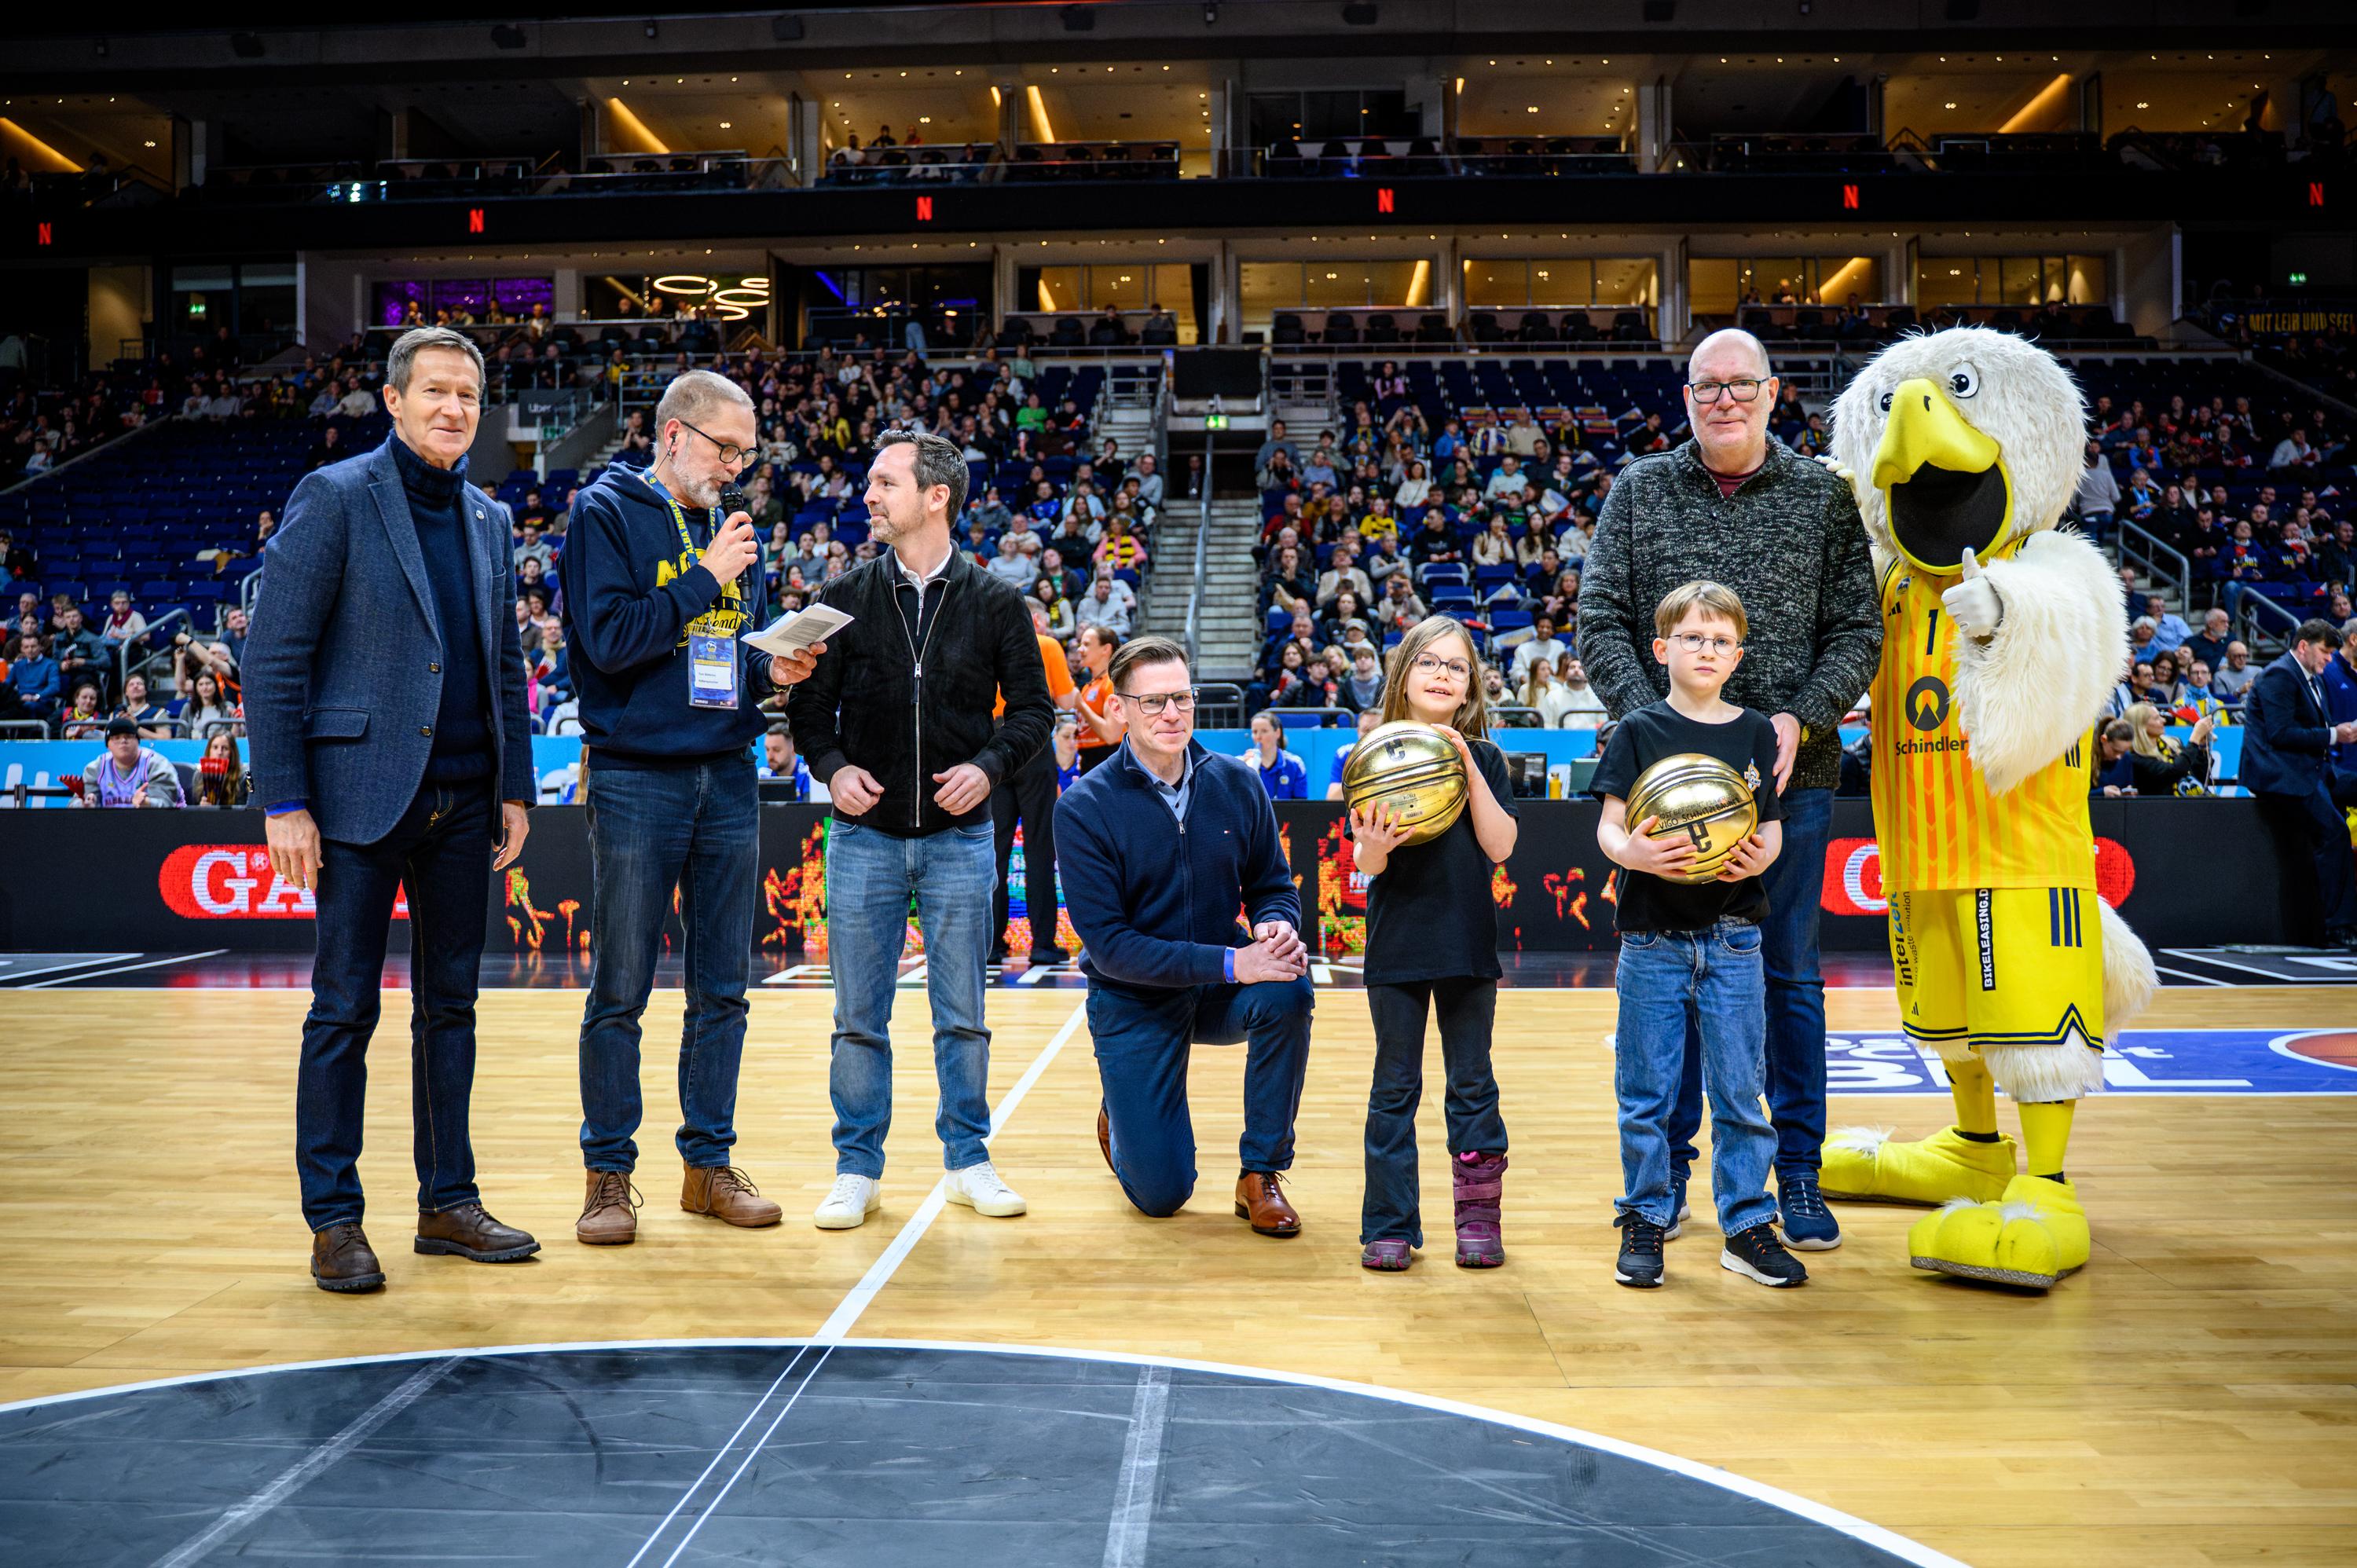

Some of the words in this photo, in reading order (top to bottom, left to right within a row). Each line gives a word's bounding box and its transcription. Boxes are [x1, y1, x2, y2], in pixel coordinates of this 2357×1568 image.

[1378, 188, 1394, 213] N
[1844, 185, 1859, 209] N
[2311, 182, 2323, 206] N
[917, 196, 933, 221] N
[470, 209, 484, 233] N
[38, 223, 51, 244] N
[2249, 313, 2271, 332] MIT
[2302, 313, 2327, 332] UND
[667, 498, 687, 530] BERLIN
[680, 529, 695, 554] ALBA
[1926, 608, 1939, 656] 1
[1895, 736, 1969, 757] Schindler
[1659, 818, 1678, 830] VIGO
[1978, 888, 1993, 988] BIKELEASING.D
